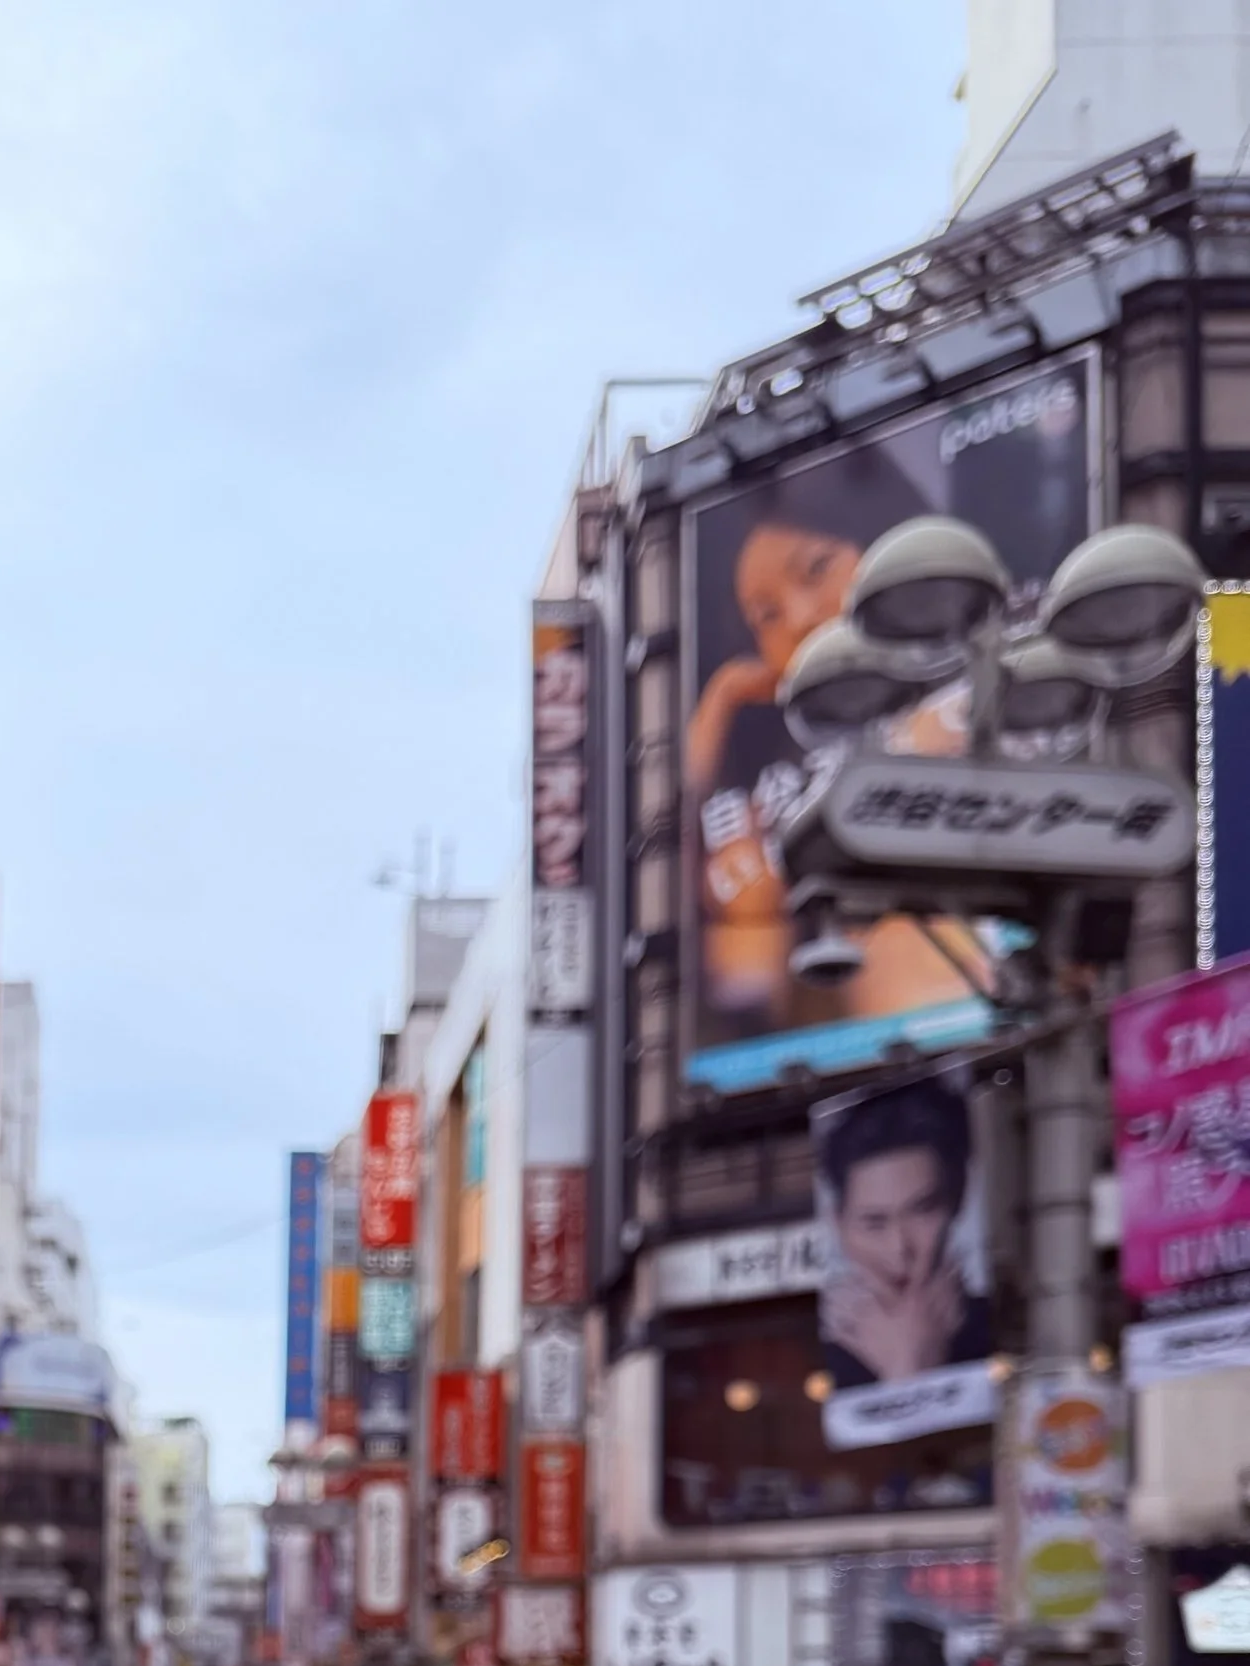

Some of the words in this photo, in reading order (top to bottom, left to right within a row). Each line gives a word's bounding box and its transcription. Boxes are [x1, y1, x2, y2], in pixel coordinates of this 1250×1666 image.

[849, 782, 1175, 842] 渋谷センター街
